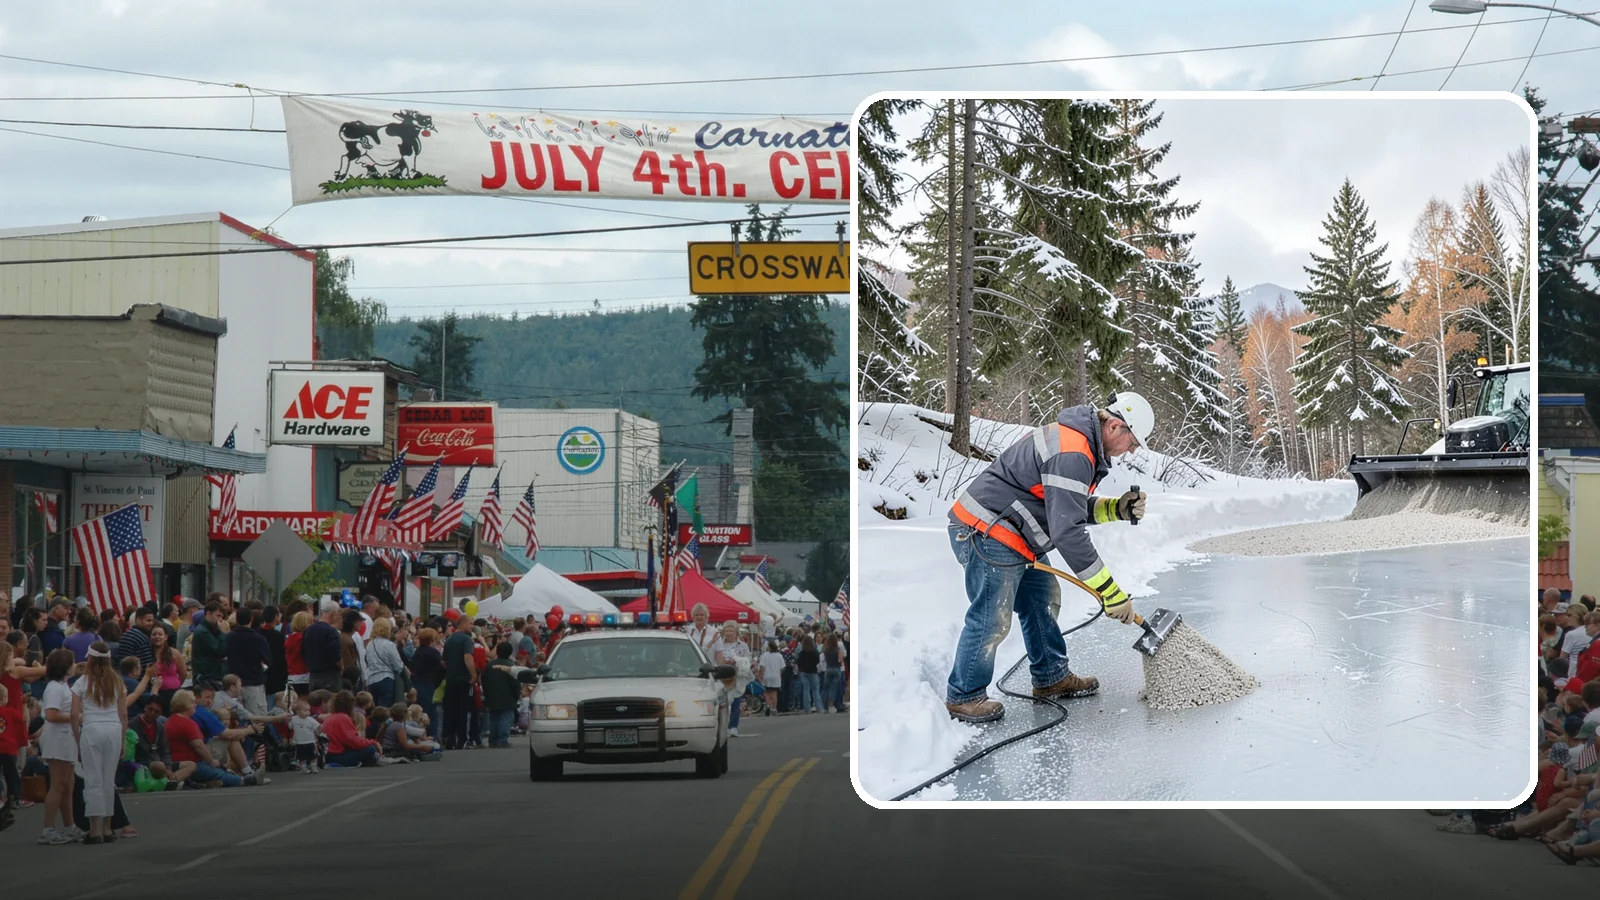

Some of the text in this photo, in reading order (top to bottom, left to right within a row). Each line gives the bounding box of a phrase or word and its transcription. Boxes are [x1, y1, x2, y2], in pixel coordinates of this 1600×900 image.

[695, 121, 850, 150] Carnat
[481, 140, 605, 193] JULY
[632, 149, 746, 198] 4th.
[696, 254, 850, 280] CROSSWA
[283, 380, 373, 420] ACE
[405, 409, 485, 423] CEDAR LOG
[283, 421, 371, 437] Hardware
[416, 428, 477, 447] Coca-Cola
[83, 485, 155, 495] St. Vincent de Paul
[688, 526, 742, 535] CRNATION
[699, 535, 731, 543] GLASS
